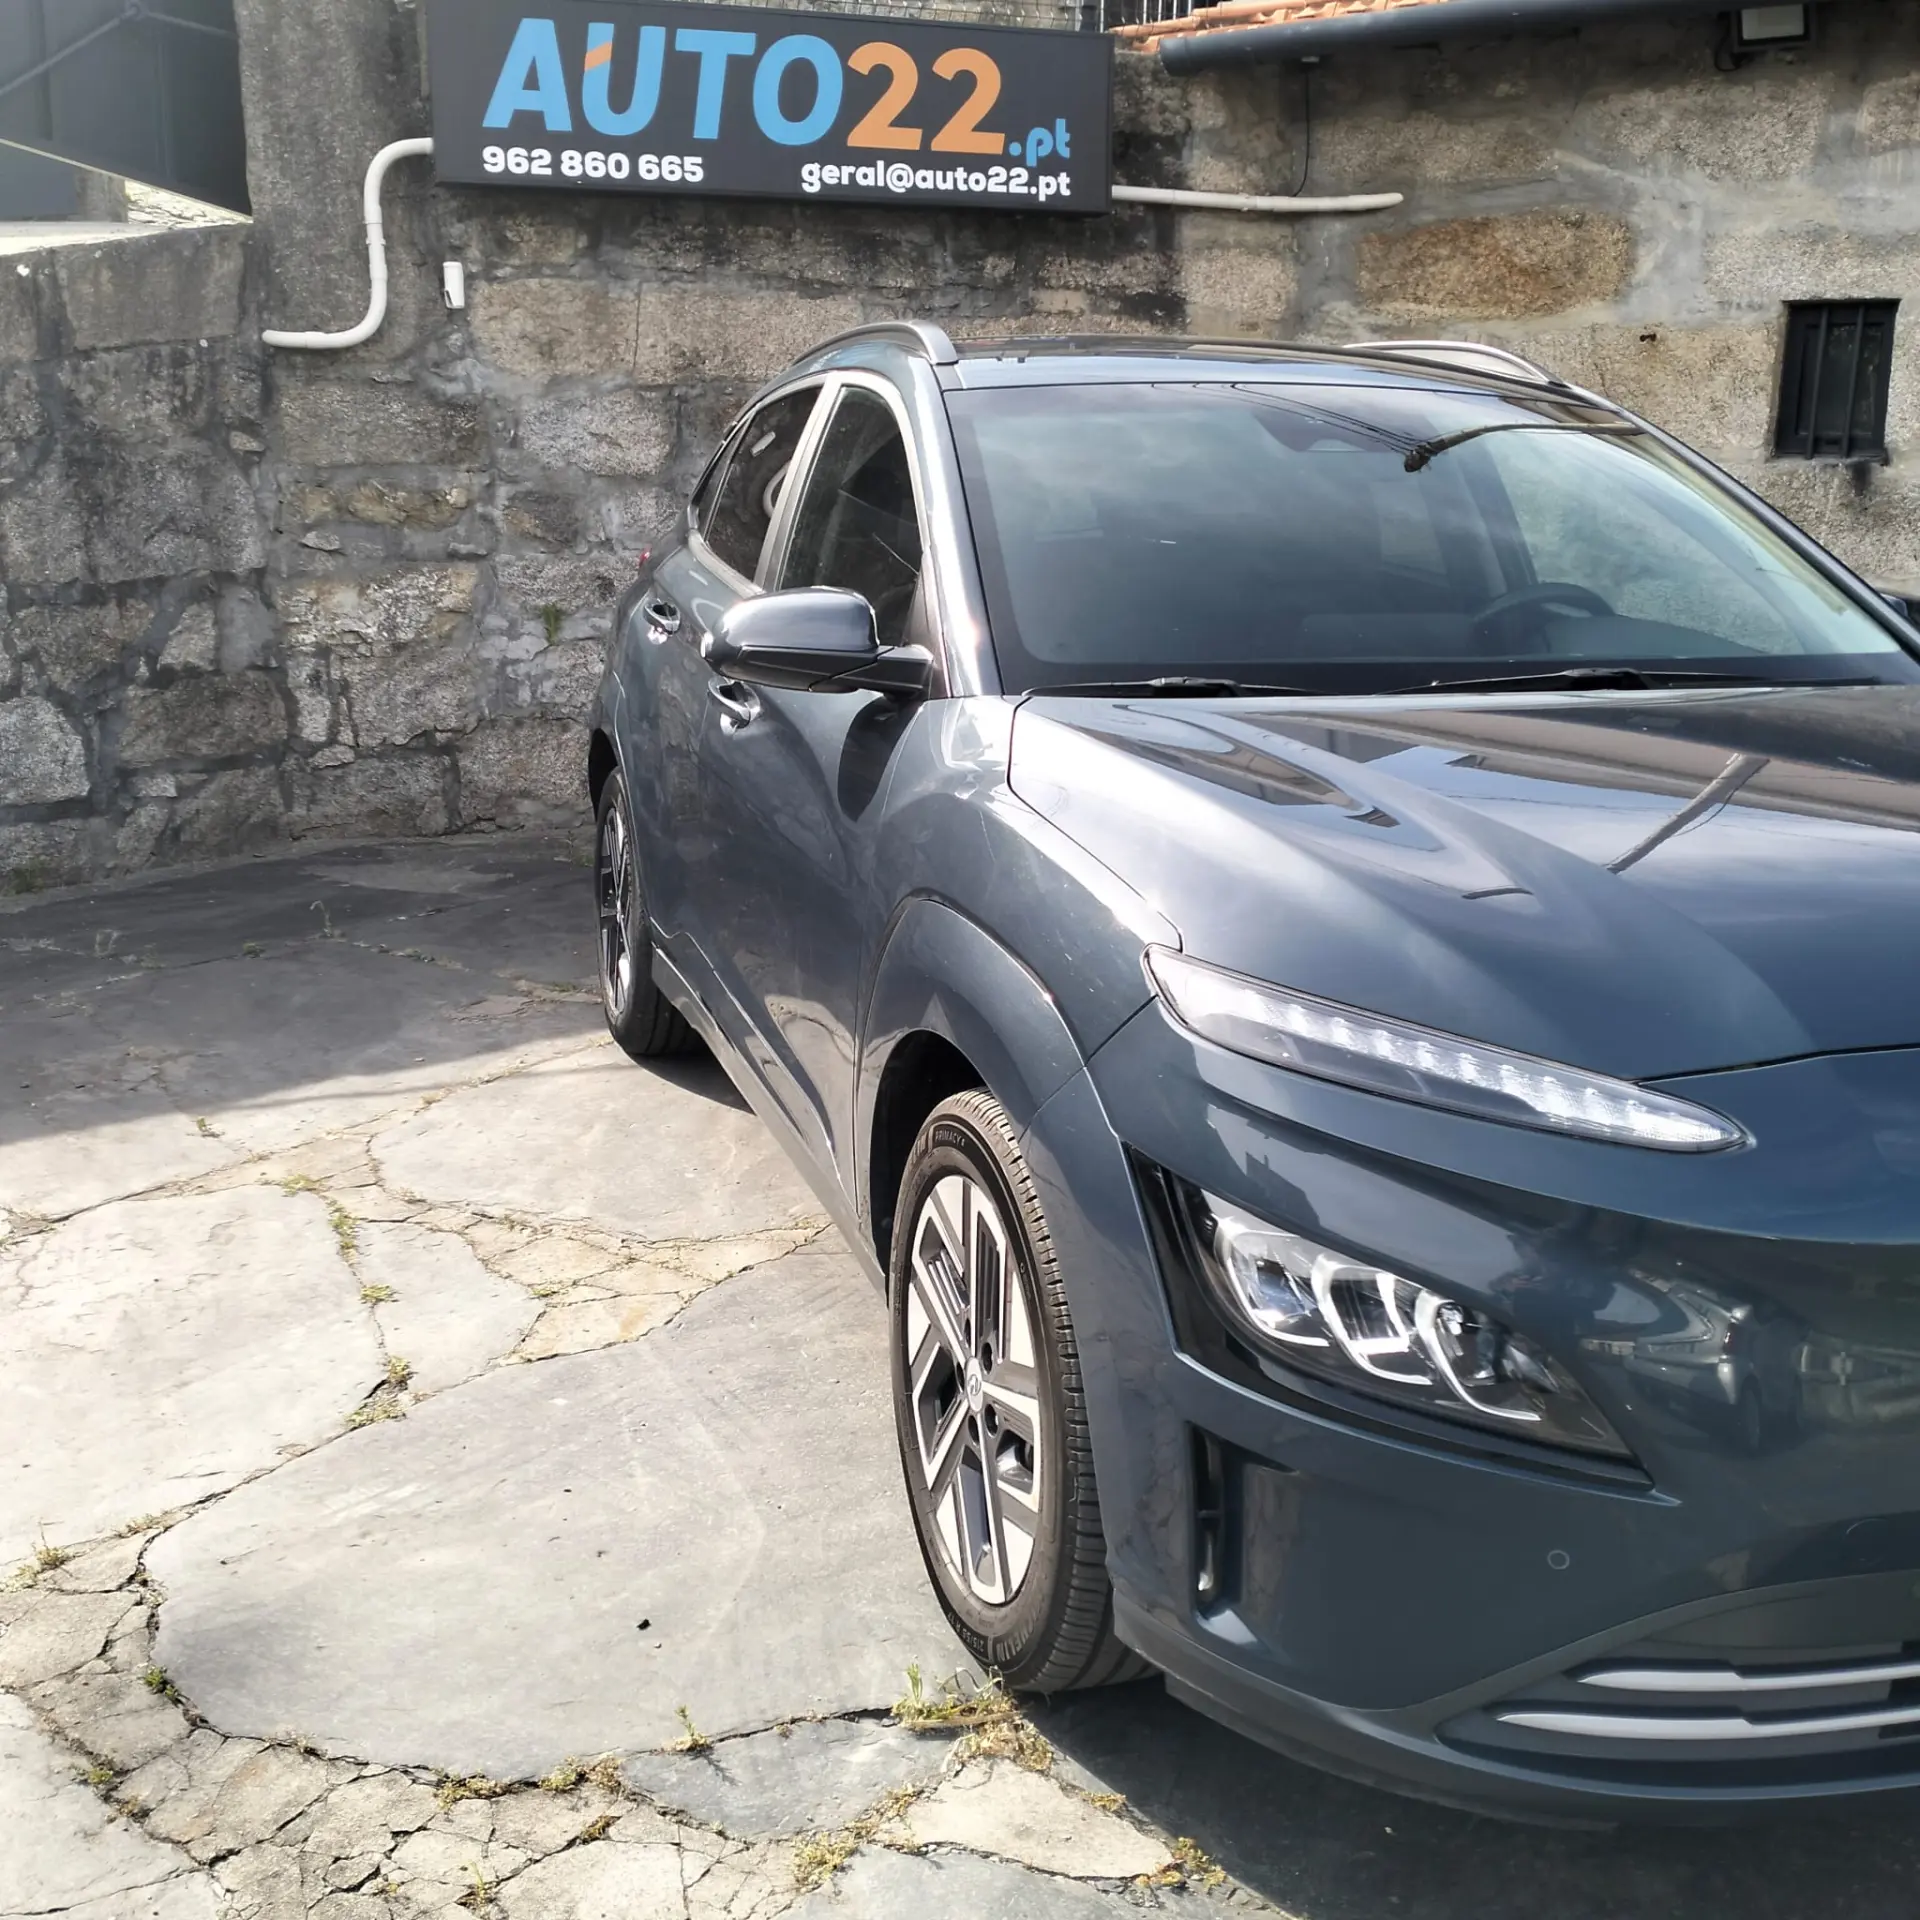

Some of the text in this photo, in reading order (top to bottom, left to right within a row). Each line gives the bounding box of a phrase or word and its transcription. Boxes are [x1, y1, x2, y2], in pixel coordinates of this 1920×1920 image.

[482, 17, 1071, 169] AUTO22.pt
[482, 145, 704, 183] 962 860 665
[800, 159, 1071, 202] geral@auto22.pt
